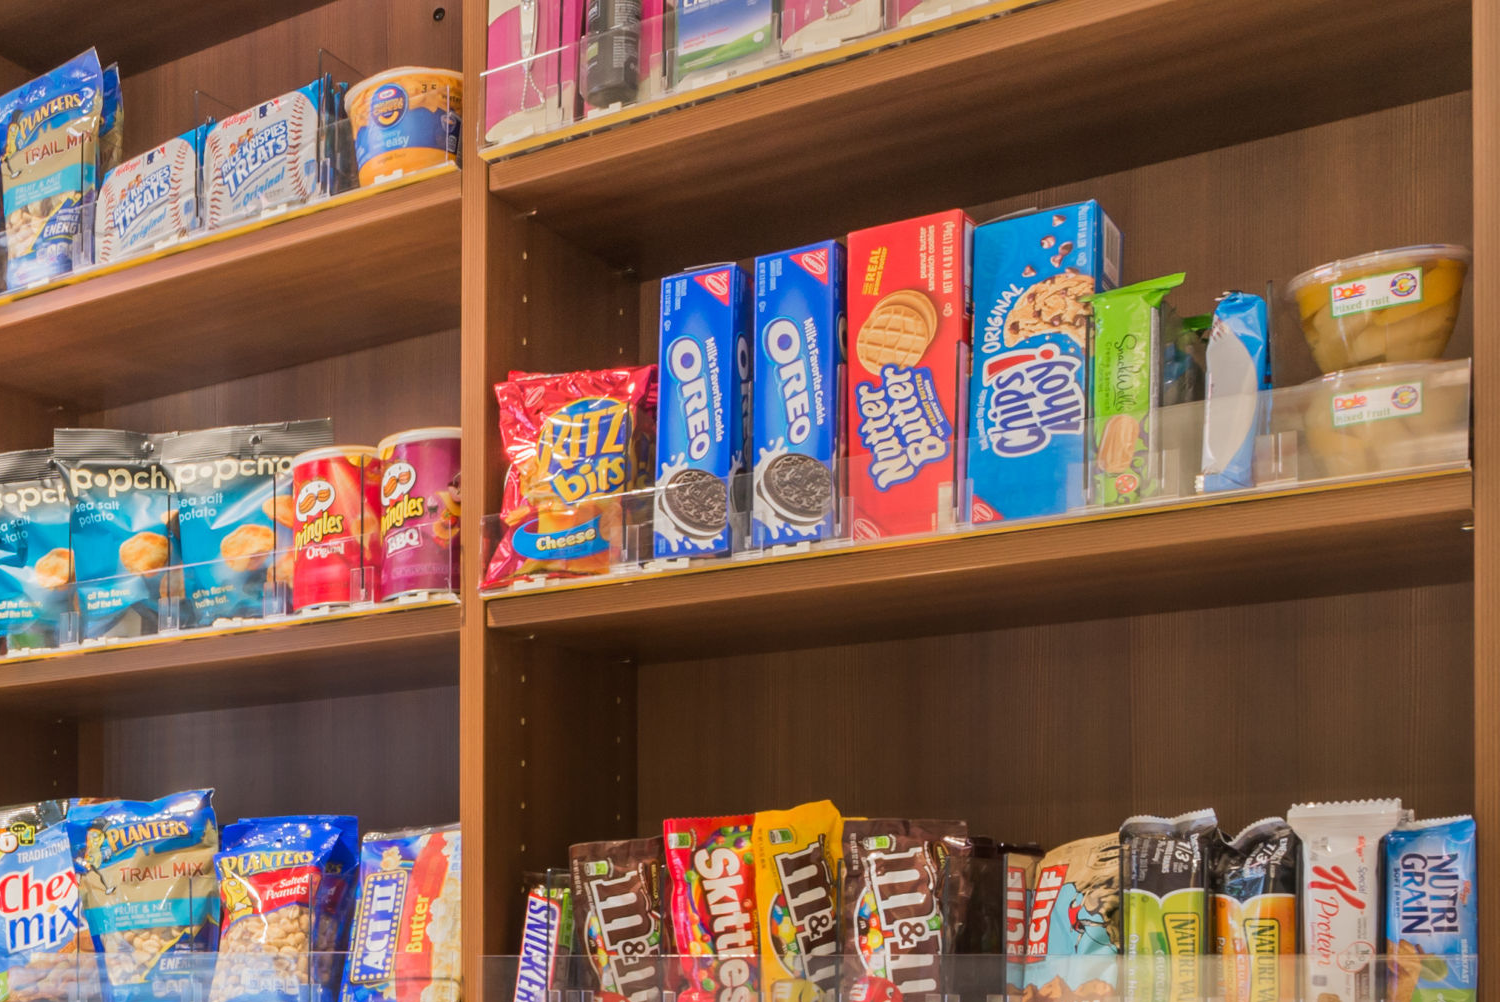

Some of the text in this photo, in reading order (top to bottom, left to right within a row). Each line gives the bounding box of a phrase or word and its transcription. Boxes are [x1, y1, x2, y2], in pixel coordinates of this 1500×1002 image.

[19, 93, 81, 140] PLANTERS
[242, 120, 288, 158] KRISPIES
[24, 130, 92, 165] TRAIL MIX
[386, 134, 410, 149] easy
[131, 165, 171, 200] KRISPIES
[225, 136, 288, 197] TREATS
[115, 180, 171, 239] TREATS
[865, 248, 882, 281] REAL
[1333, 283, 1366, 299] Dole
[982, 284, 1024, 353] ORIGINAL
[704, 336, 723, 442] Milk's Favorite Cookie
[767, 319, 811, 446] OREO
[804, 317, 824, 425] Milk's Favorite Cookie
[670, 338, 711, 460] OREO
[884, 367, 947, 467] Butter
[991, 372, 1046, 453] Chips
[1335, 395, 1367, 411] Dole
[541, 403, 628, 475] RITZ
[858, 385, 914, 489] Nutter
[201, 493, 223, 505] salt
[556, 458, 626, 503] bits
[11, 515, 31, 527] salt
[75, 500, 119, 513] sea salt
[79, 511, 115, 528] potato
[179, 508, 217, 523] potato
[295, 512, 343, 561] Pringles
[387, 529, 419, 552] BBQ
[536, 528, 597, 551] Cheese
[108, 819, 189, 852] PLANTERS
[120, 862, 205, 883] TRAIL MIX
[221, 851, 315, 876] PLANTERS
[279, 874, 309, 889] Salted
[1357, 866, 1368, 894] Special
[114, 903, 172, 915] FRUIT NUT
[266, 885, 307, 901] Peanuts
[1007, 871, 1025, 941] CLIF
[1029, 871, 1062, 942] CLIF
[1309, 866, 1366, 909] K
[1401, 854, 1431, 934] GRAIN
[1427, 852, 1459, 933] NUTRI
[363, 918, 394, 971] ACT
[406, 895, 429, 953] Butter
[1315, 897, 1339, 966] Protein
[1169, 918, 1196, 978] NATURE
[1250, 924, 1275, 985] NATURE
